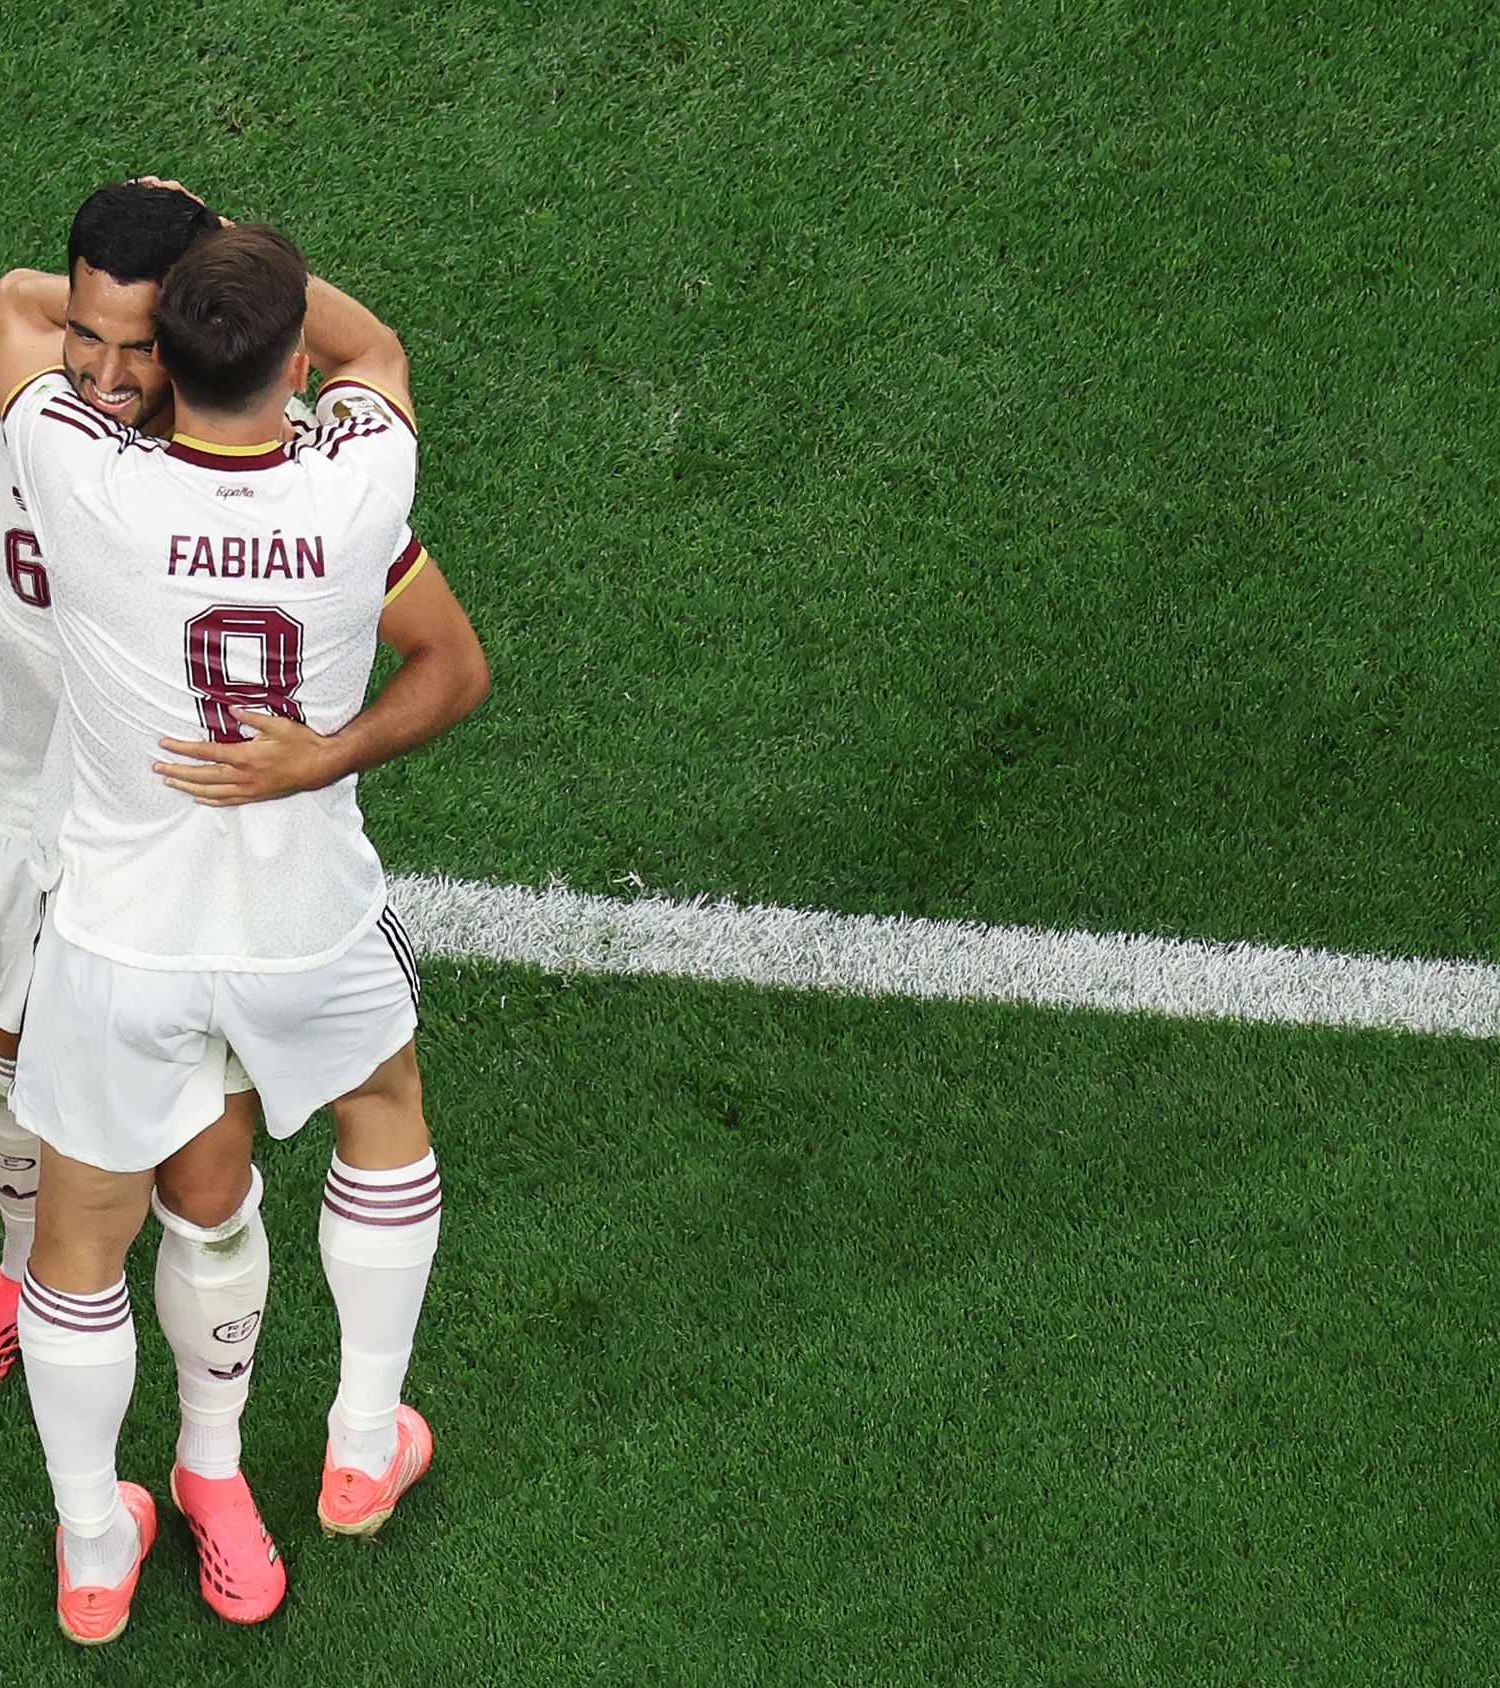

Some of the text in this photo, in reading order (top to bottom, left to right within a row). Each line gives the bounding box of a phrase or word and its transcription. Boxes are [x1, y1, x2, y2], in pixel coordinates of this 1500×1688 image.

[4, 527, 52, 609] 6
[168, 529, 325, 579] FABIÁN
[184, 604, 306, 744] 8
